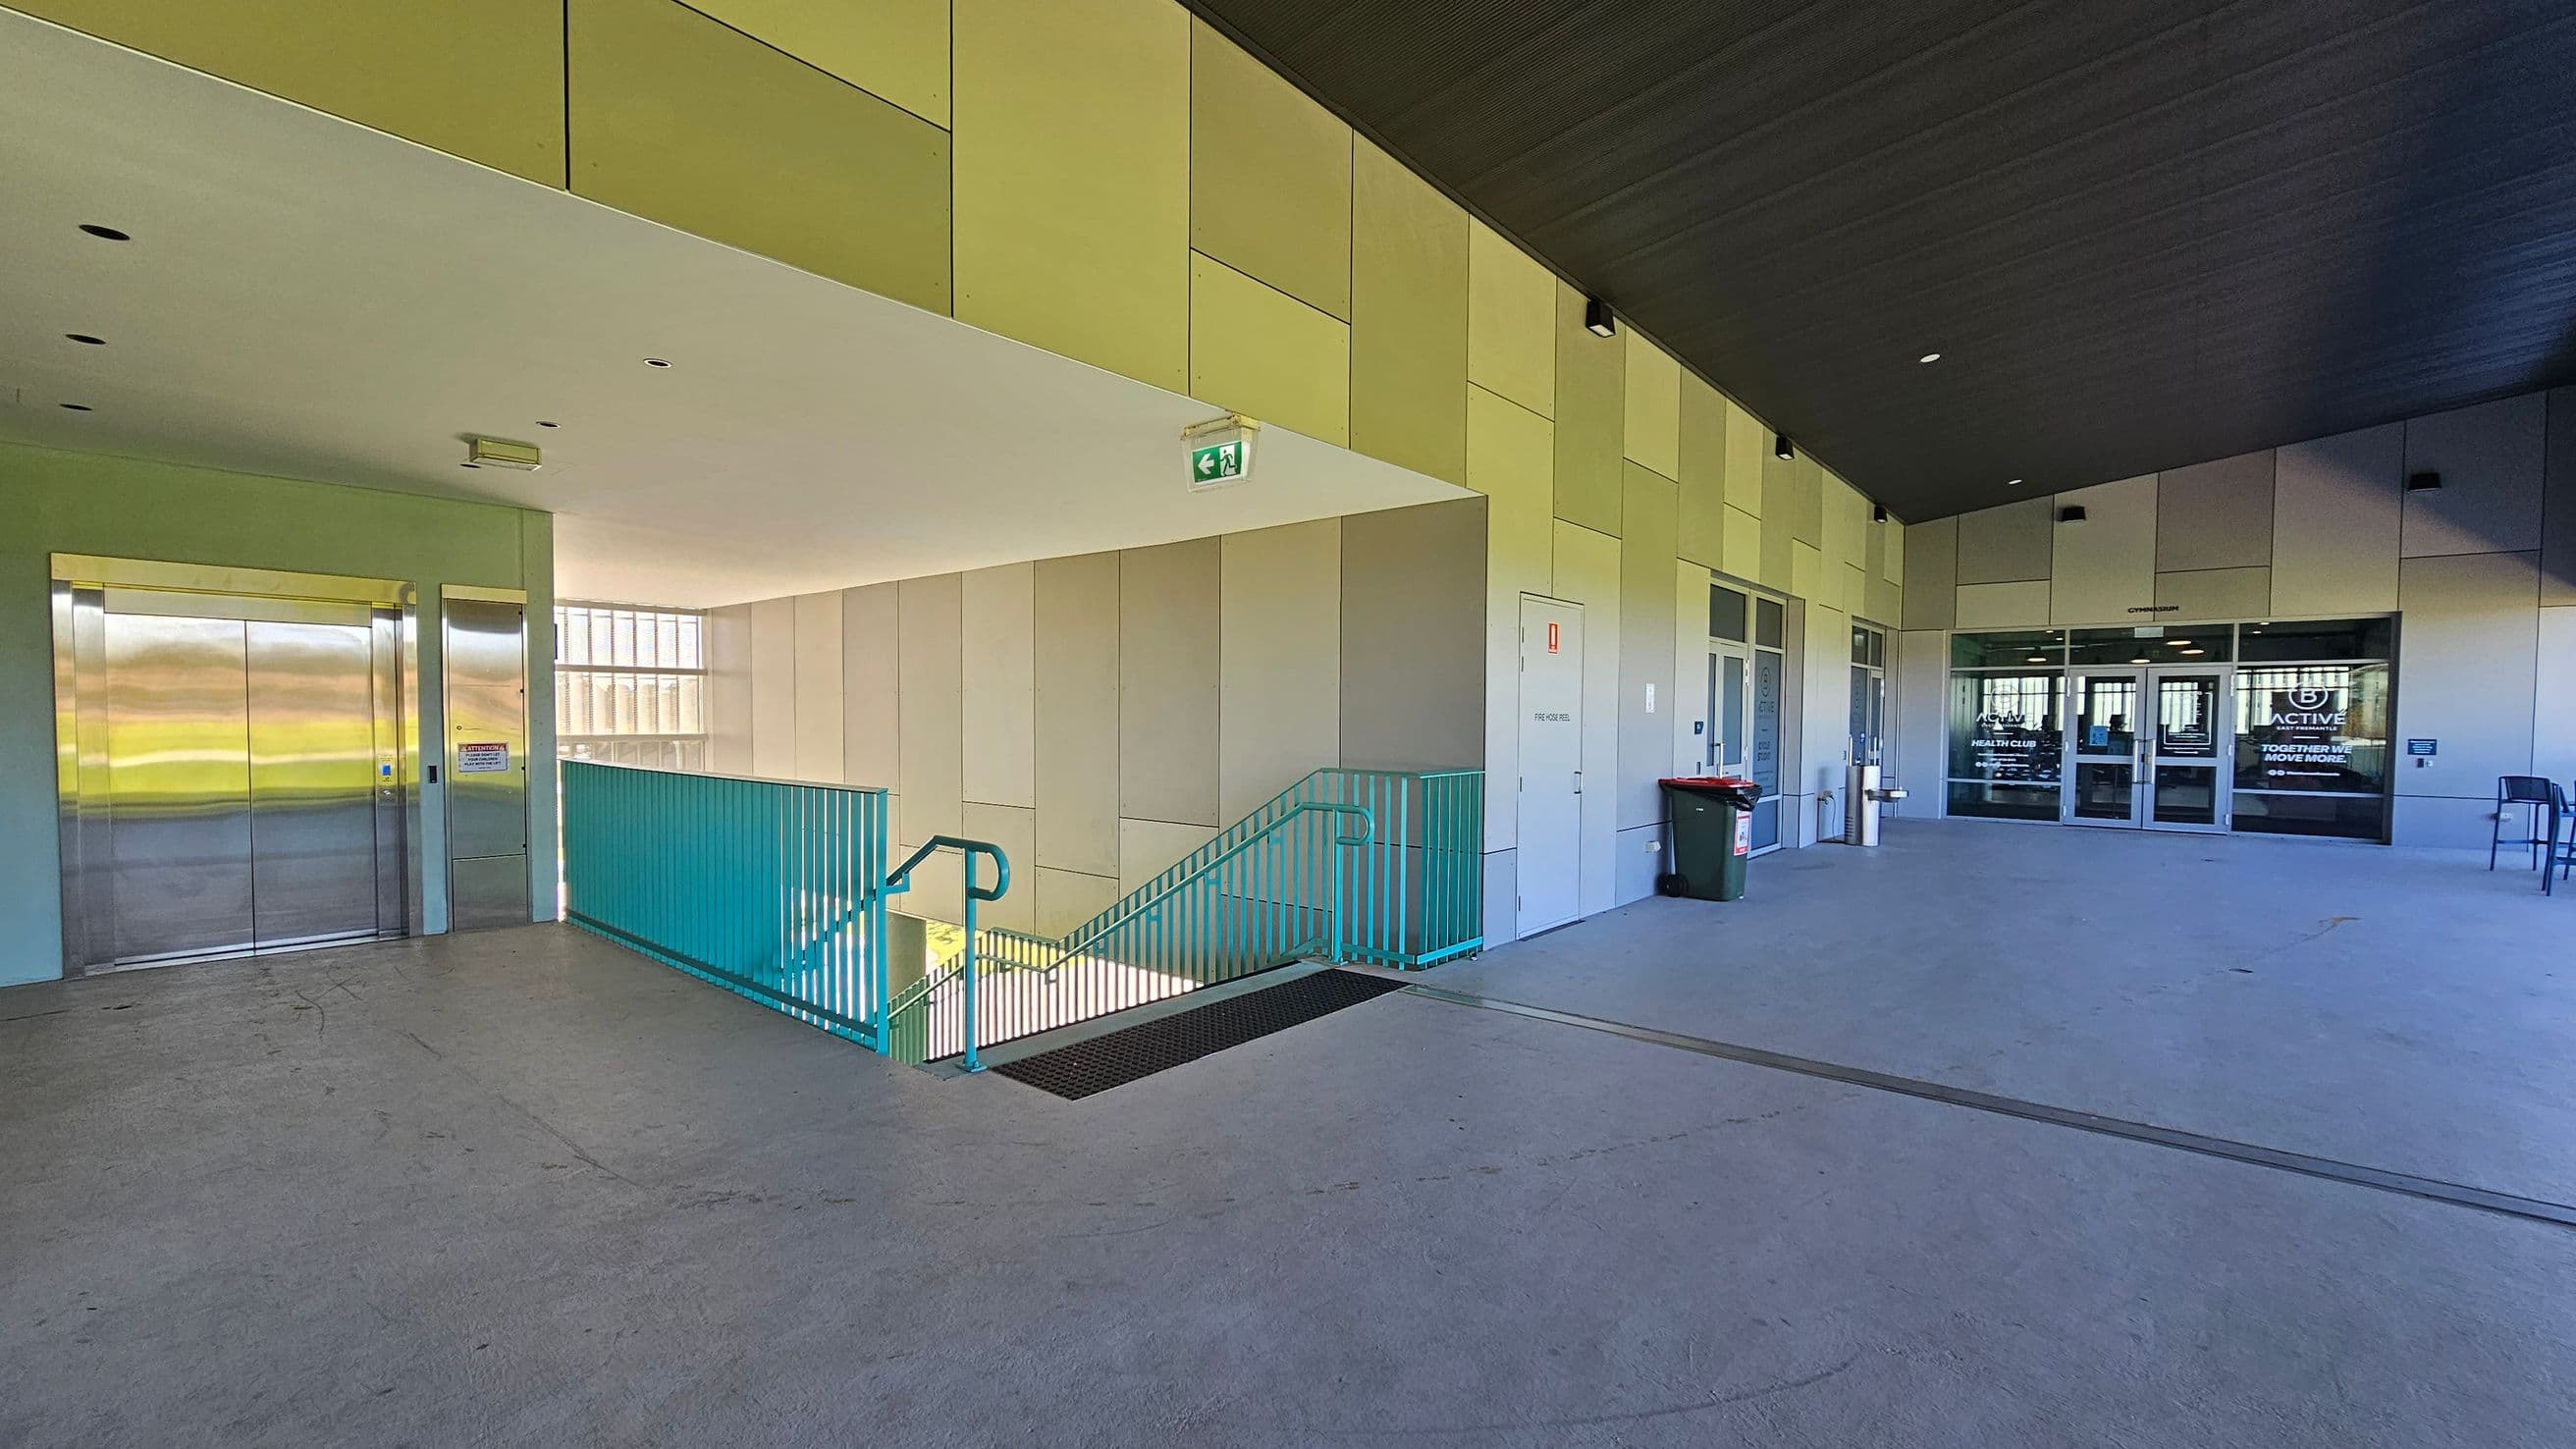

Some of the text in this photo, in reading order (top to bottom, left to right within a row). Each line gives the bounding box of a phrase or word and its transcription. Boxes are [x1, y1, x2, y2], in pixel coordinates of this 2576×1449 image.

[1534, 713, 1571, 723] FIRE HOSE REEL
[2270, 713, 2347, 725] ACTIVE
[2010, 739, 2037, 748] CLUB
[2261, 744, 2353, 754] TOGETHER WE
[2264, 753, 2347, 763] MOVE MORE.
